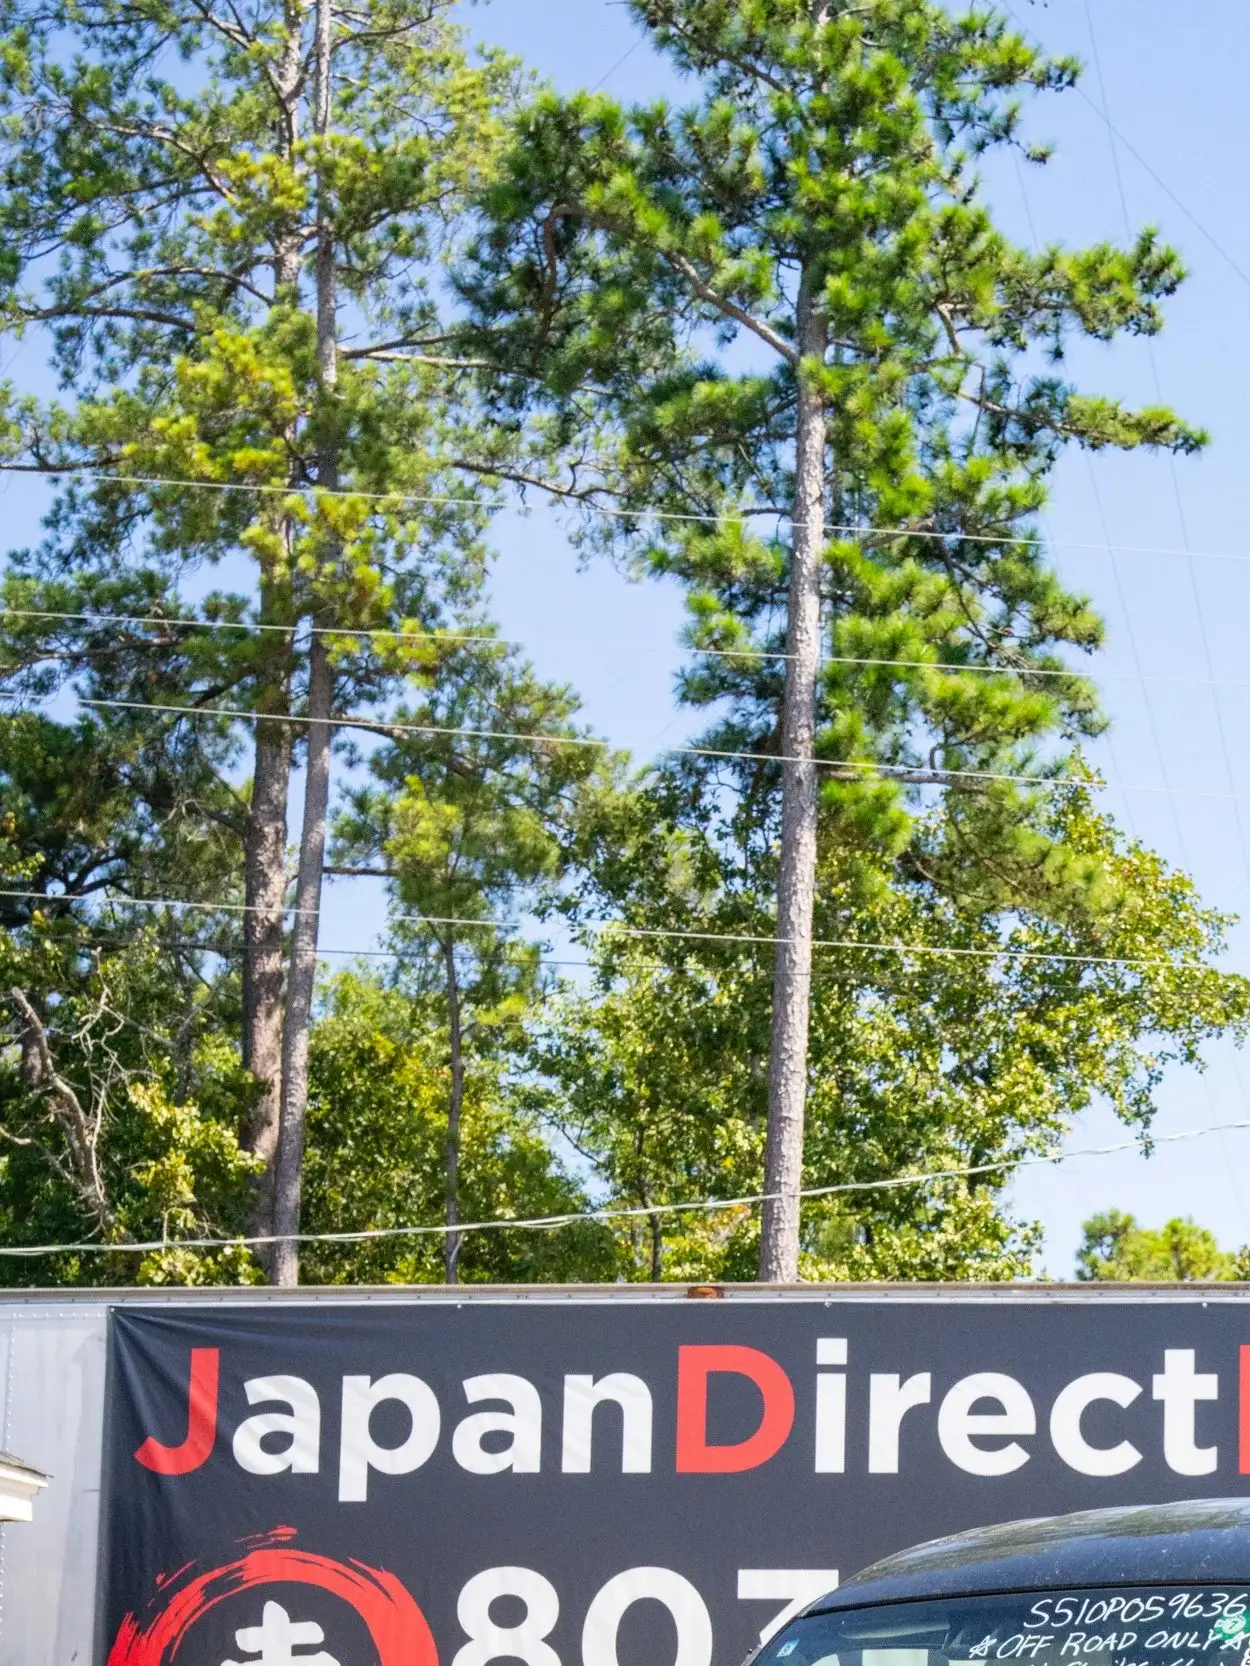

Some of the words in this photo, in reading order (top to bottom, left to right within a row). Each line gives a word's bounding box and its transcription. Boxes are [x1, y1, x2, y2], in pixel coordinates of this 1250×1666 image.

[996, 1635, 1056, 1659] OFF
[1060, 1631, 1138, 1656] ROAD
[1144, 1630, 1223, 1651] ONLY
